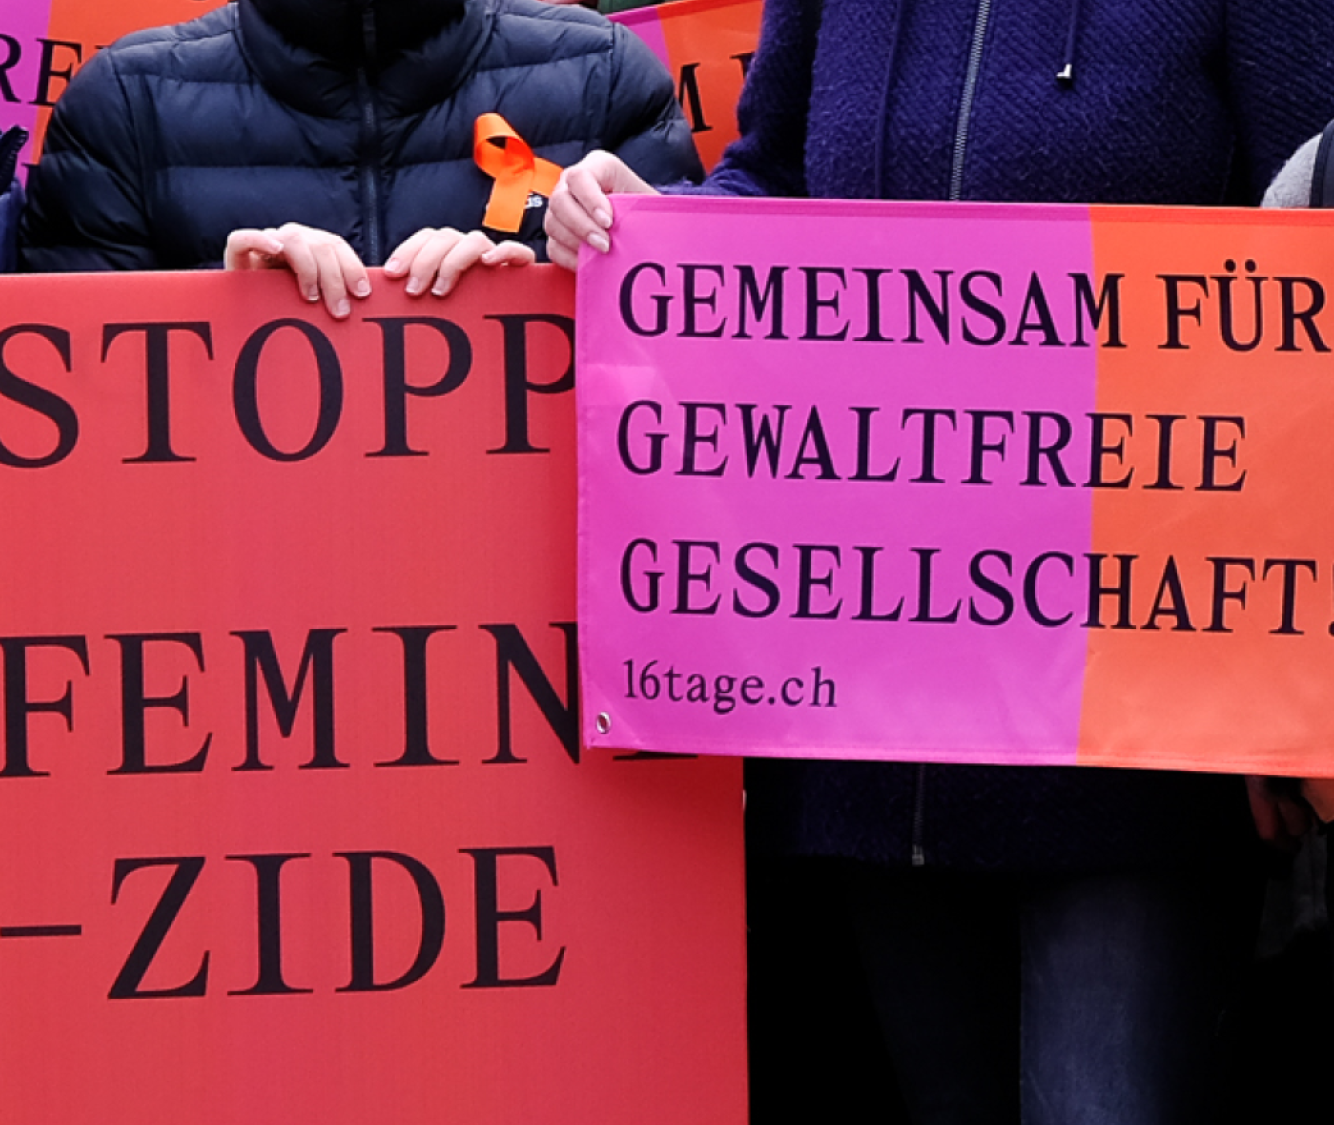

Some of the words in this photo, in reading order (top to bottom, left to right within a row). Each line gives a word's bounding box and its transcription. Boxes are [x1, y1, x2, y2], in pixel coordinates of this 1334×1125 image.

[619, 261, 1128, 348] GEMEINSAM
[1157, 259, 1332, 353] FÜR
[617, 400, 1248, 494] GEWALTFREIE
[622, 659, 837, 717] 16tage.ch
